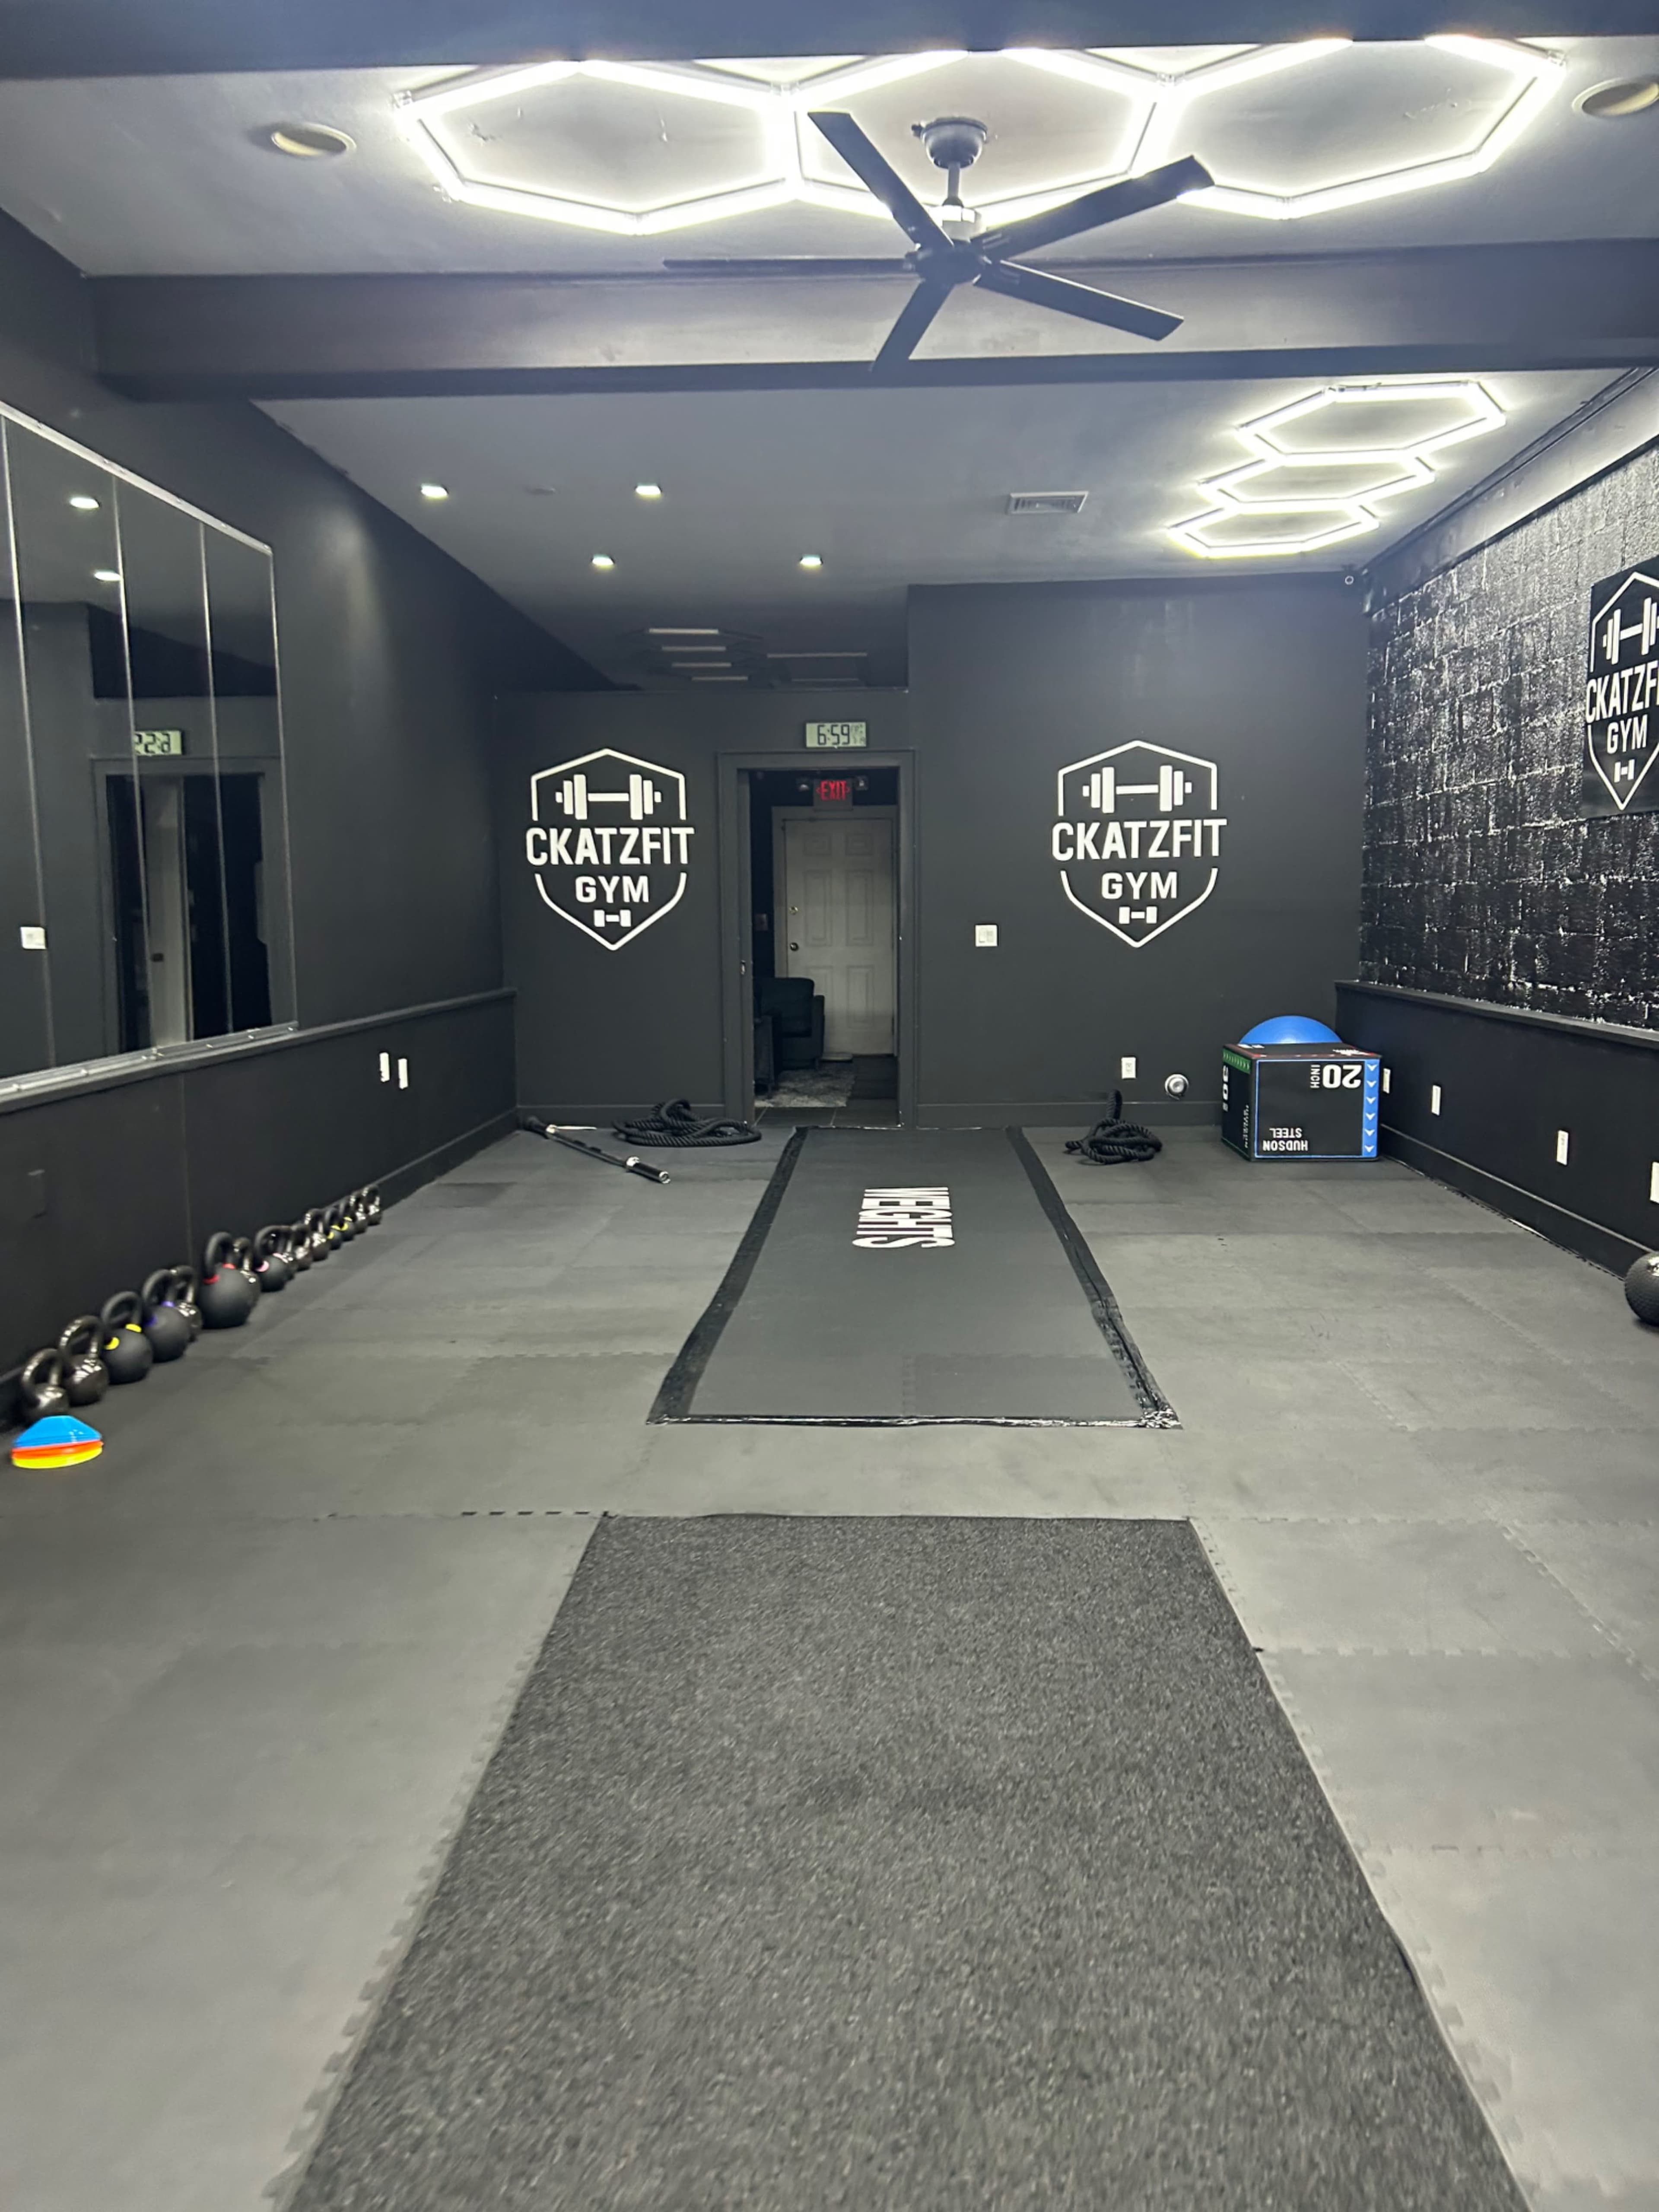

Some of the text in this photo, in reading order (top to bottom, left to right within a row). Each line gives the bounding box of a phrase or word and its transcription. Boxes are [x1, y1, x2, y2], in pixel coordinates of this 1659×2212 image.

[1586, 660, 1659, 724] CKATZF
[817, 724, 850, 745] 6:59
[1607, 714, 1648, 754] GYM
[820, 780, 847, 801] EXIT
[526, 827, 695, 866] CKATZFIT
[1052, 818, 1227, 861] CKATZFIT
[575, 875, 649, 903] GYM
[1101, 871, 1177, 900] GYM
[1310, 1064, 1362, 1088] 20 INCH
[1262, 1140, 1308, 1151] HUDSON
[1269, 1128, 1302, 1138] STEEL
[852, 1186, 955, 1249] WEIGHTS
